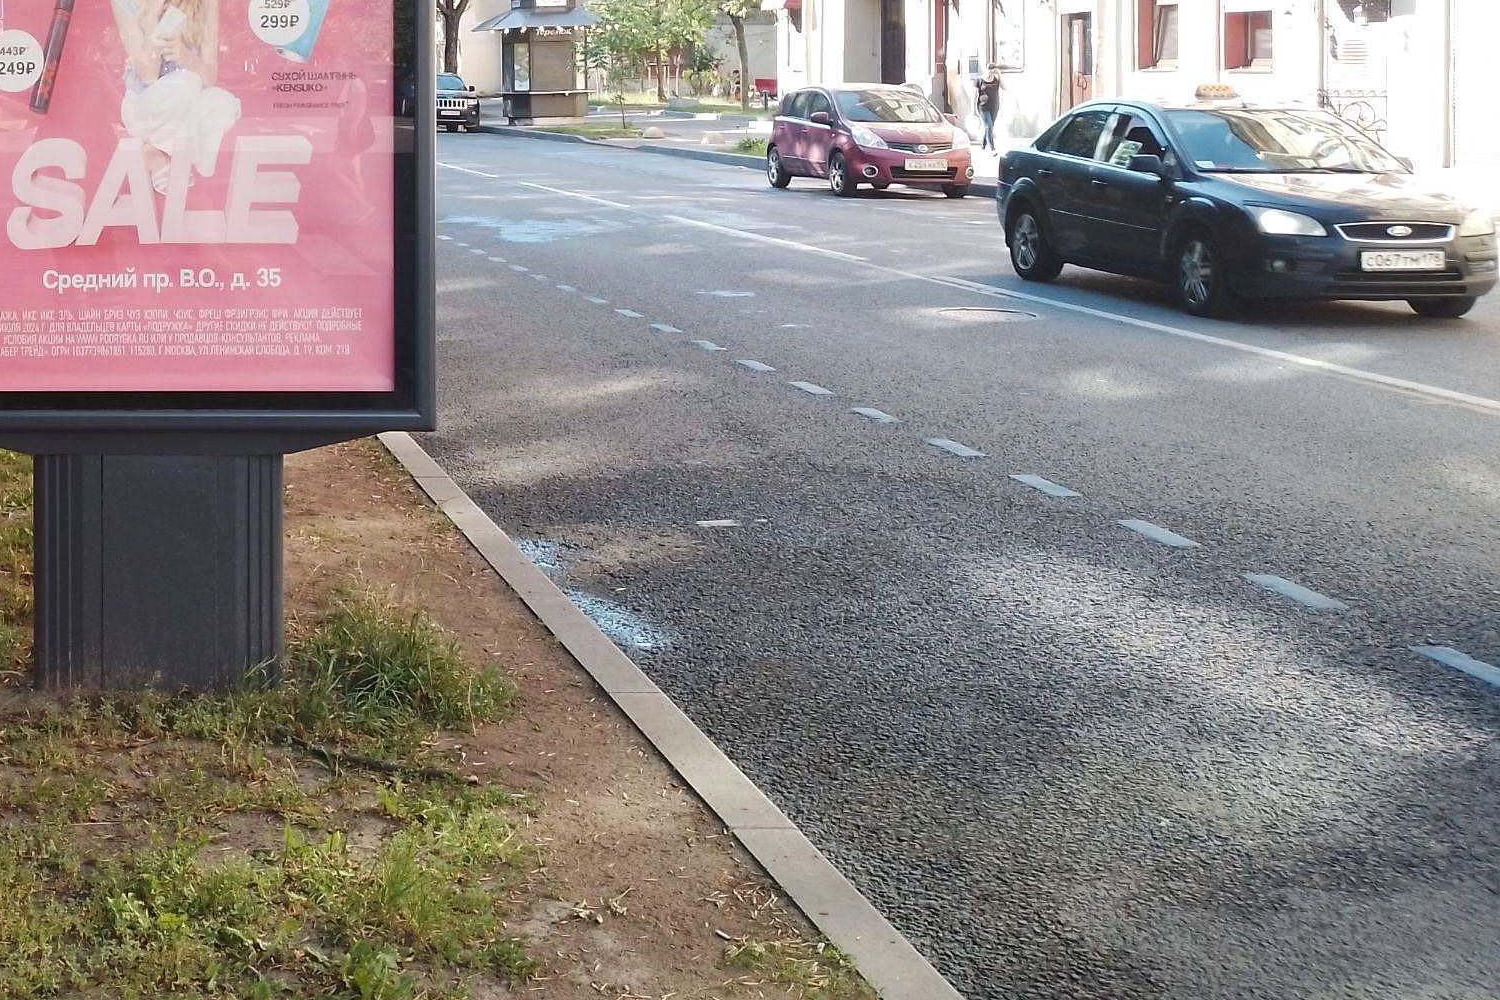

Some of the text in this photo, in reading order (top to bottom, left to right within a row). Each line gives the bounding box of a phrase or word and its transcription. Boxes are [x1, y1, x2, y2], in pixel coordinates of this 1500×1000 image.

[260, 14, 300, 29] 299₽
[271, 68, 305, 81] СУХОЙ
[6, 135, 313, 250] SALE
[42, 267, 282, 293] Средний пр. В.О., д. 35
